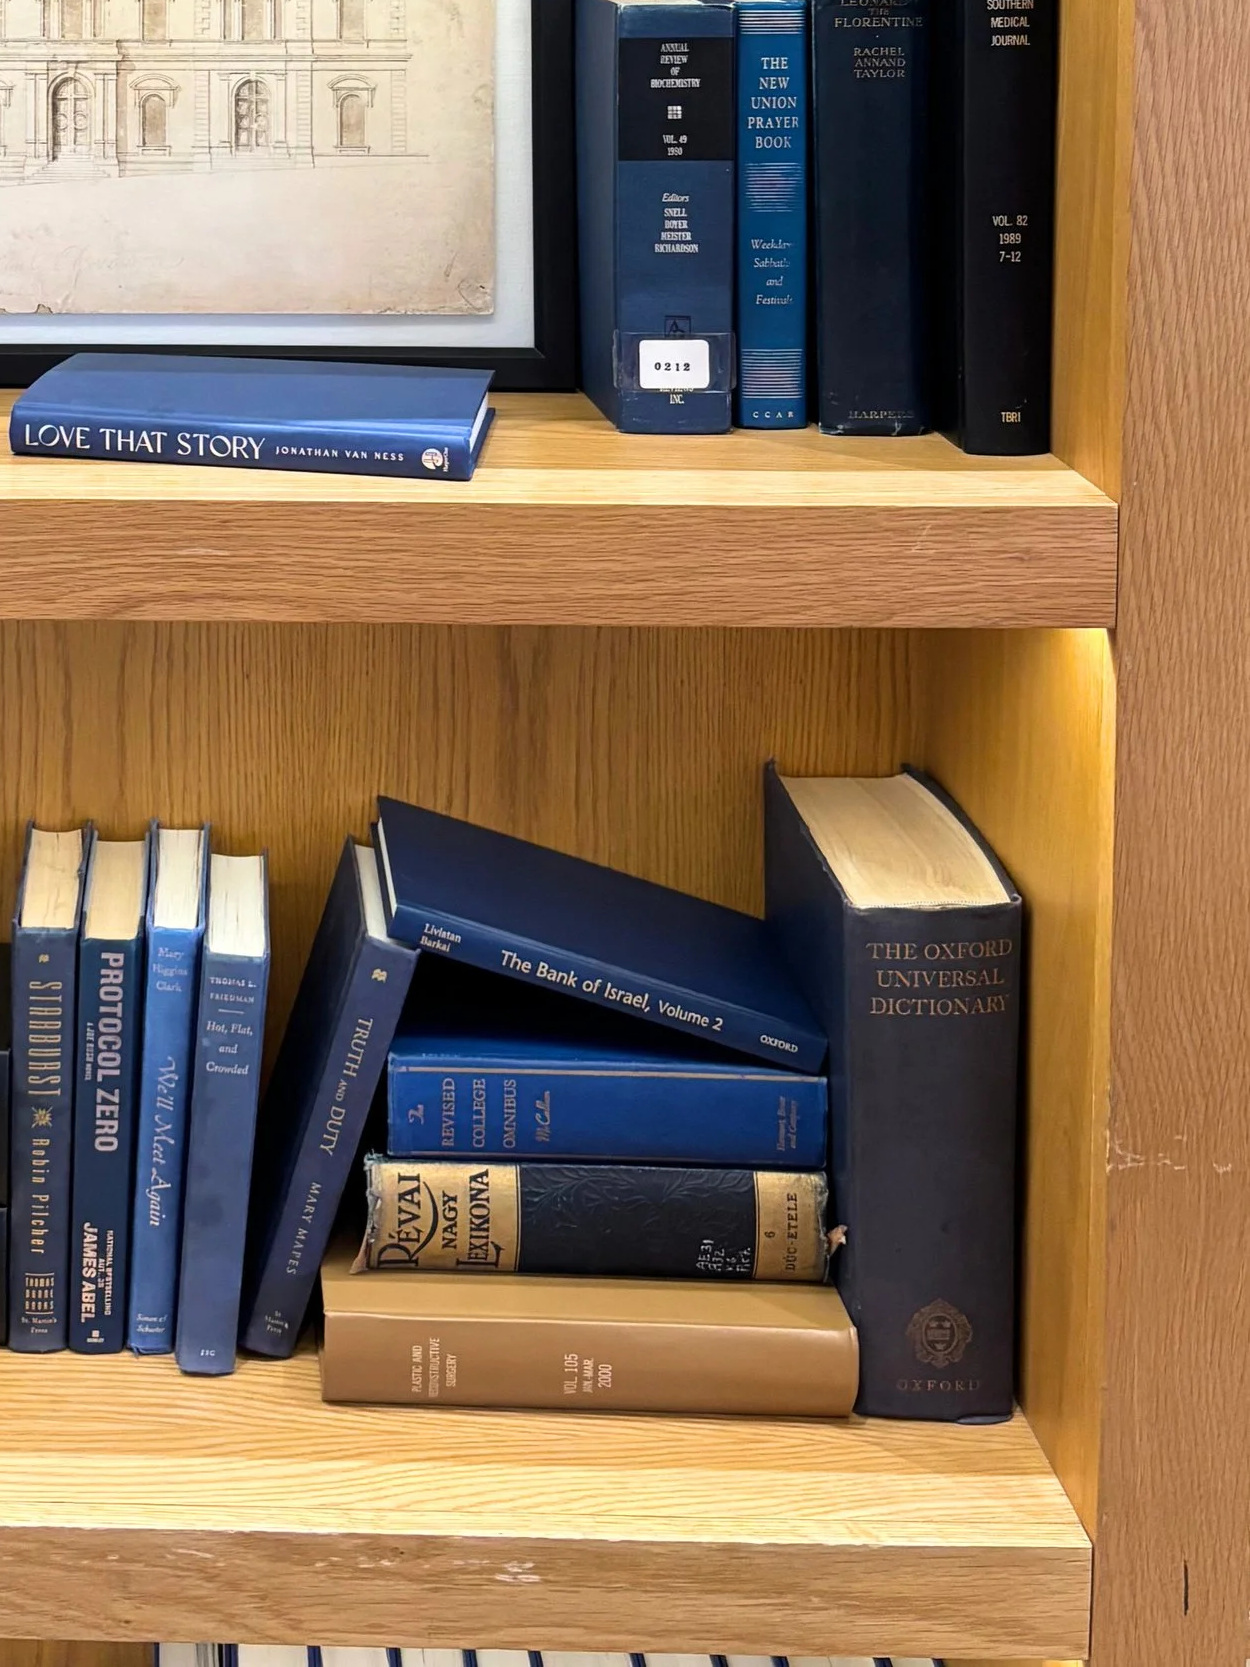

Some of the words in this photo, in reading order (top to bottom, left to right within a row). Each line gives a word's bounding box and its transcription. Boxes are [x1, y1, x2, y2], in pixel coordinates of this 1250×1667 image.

[990, 16, 1030, 29] MEDICAL
[990, 34, 1031, 47] JOURNAL
[759, 76, 791, 90] NEW
[761, 56, 789, 69] THE
[748, 115, 800, 129] PRAYER
[751, 96, 798, 109] UNION
[756, 136, 793, 149] BOOK
[999, 233, 1021, 245] 1989
[654, 361, 691, 372] 0212
[1000, 411, 1021, 423] TBRI
[25, 423, 91, 450] LOVE
[100, 428, 168, 454] THAT
[176, 432, 266, 460] STORY
[275, 446, 339, 459] JONATHAN
[345, 449, 368, 460] VAN
[374, 451, 405, 462] NESS
[866, 942, 917, 961] THE
[923, 938, 1012, 961] OXFORD
[501, 950, 533, 974] The
[535, 961, 578, 989] Bank
[581, 976, 603, 995] of
[604, 981, 653, 1013] Israel,
[658, 1000, 709, 1029] Volume
[711, 1015, 724, 1032] 2
[876, 966, 1005, 989] UNIVERSAL
[96, 952, 125, 1081] PROTOCOL
[870, 993, 1008, 1016] DICTIONARY
[27, 981, 63, 1097] STARBURST
[342, 1017, 374, 1077] TRUTH
[759, 1034, 799, 1053] OXFORD
[155, 1056, 180, 1110] We'll
[334, 1079, 349, 1102] AND
[93, 1088, 121, 1153] ZERO
[318, 1105, 346, 1157] DUTY
[441, 1077, 455, 1148] REVISED
[472, 1078, 486, 1149] COLLEGE
[503, 1079, 517, 1149] OMNIBUS
[30, 1138, 52, 1183] Robin
[151, 1114, 175, 1165] Meet
[146, 1167, 173, 1227] Again
[300, 1182, 323, 1224] MARY
[455, 1168, 505, 1268] LEXIKONA
[30, 1194, 52, 1254] Pilcher
[442, 1190, 458, 1250] NAGY
[82, 1222, 99, 1279] JAMES
[285, 1227, 309, 1276] MAPES
[80, 1281, 98, 1324] ABEL
